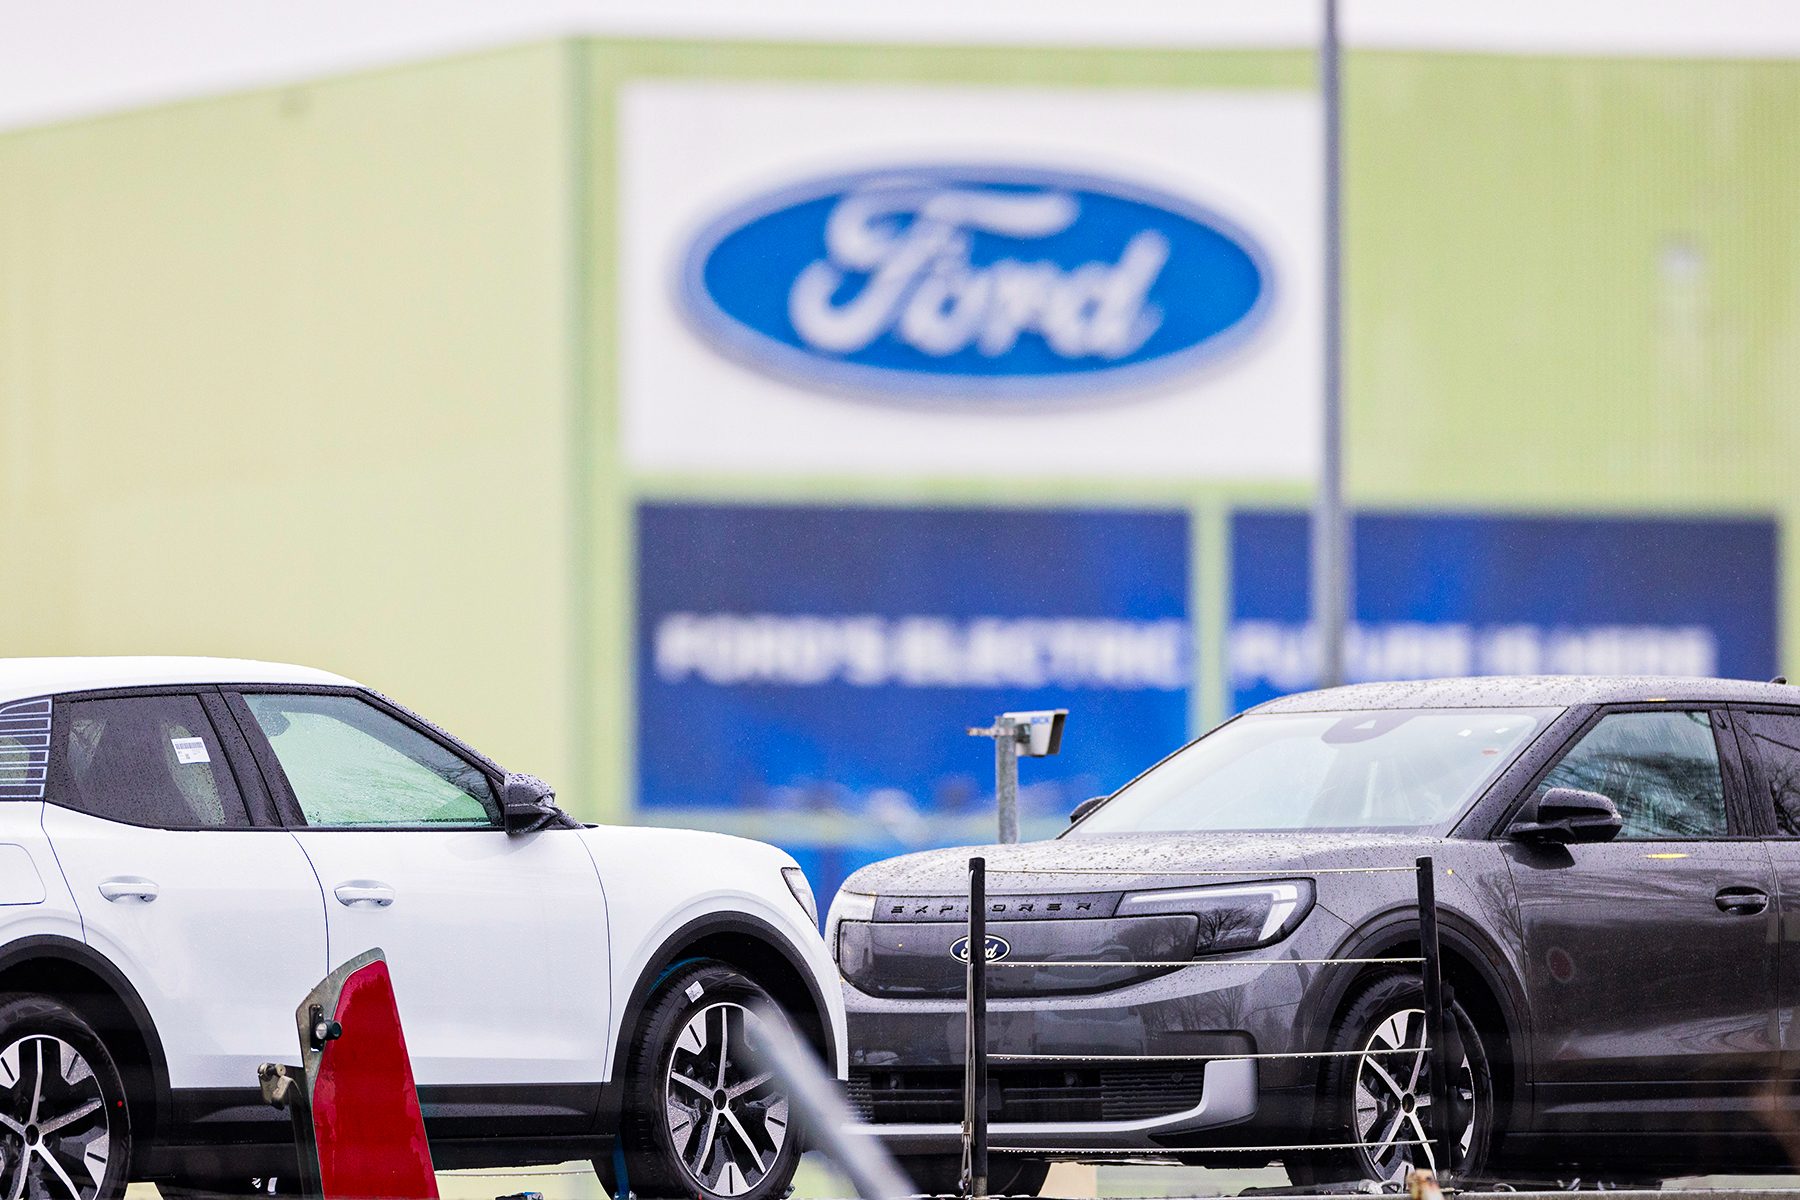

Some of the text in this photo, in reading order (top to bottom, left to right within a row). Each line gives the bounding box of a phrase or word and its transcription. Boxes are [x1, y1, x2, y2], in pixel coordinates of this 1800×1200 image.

[789, 178, 1170, 360] Ford
[901, 618, 1189, 689] ELECTRIC
[891, 902, 1092, 915] EXPORER
